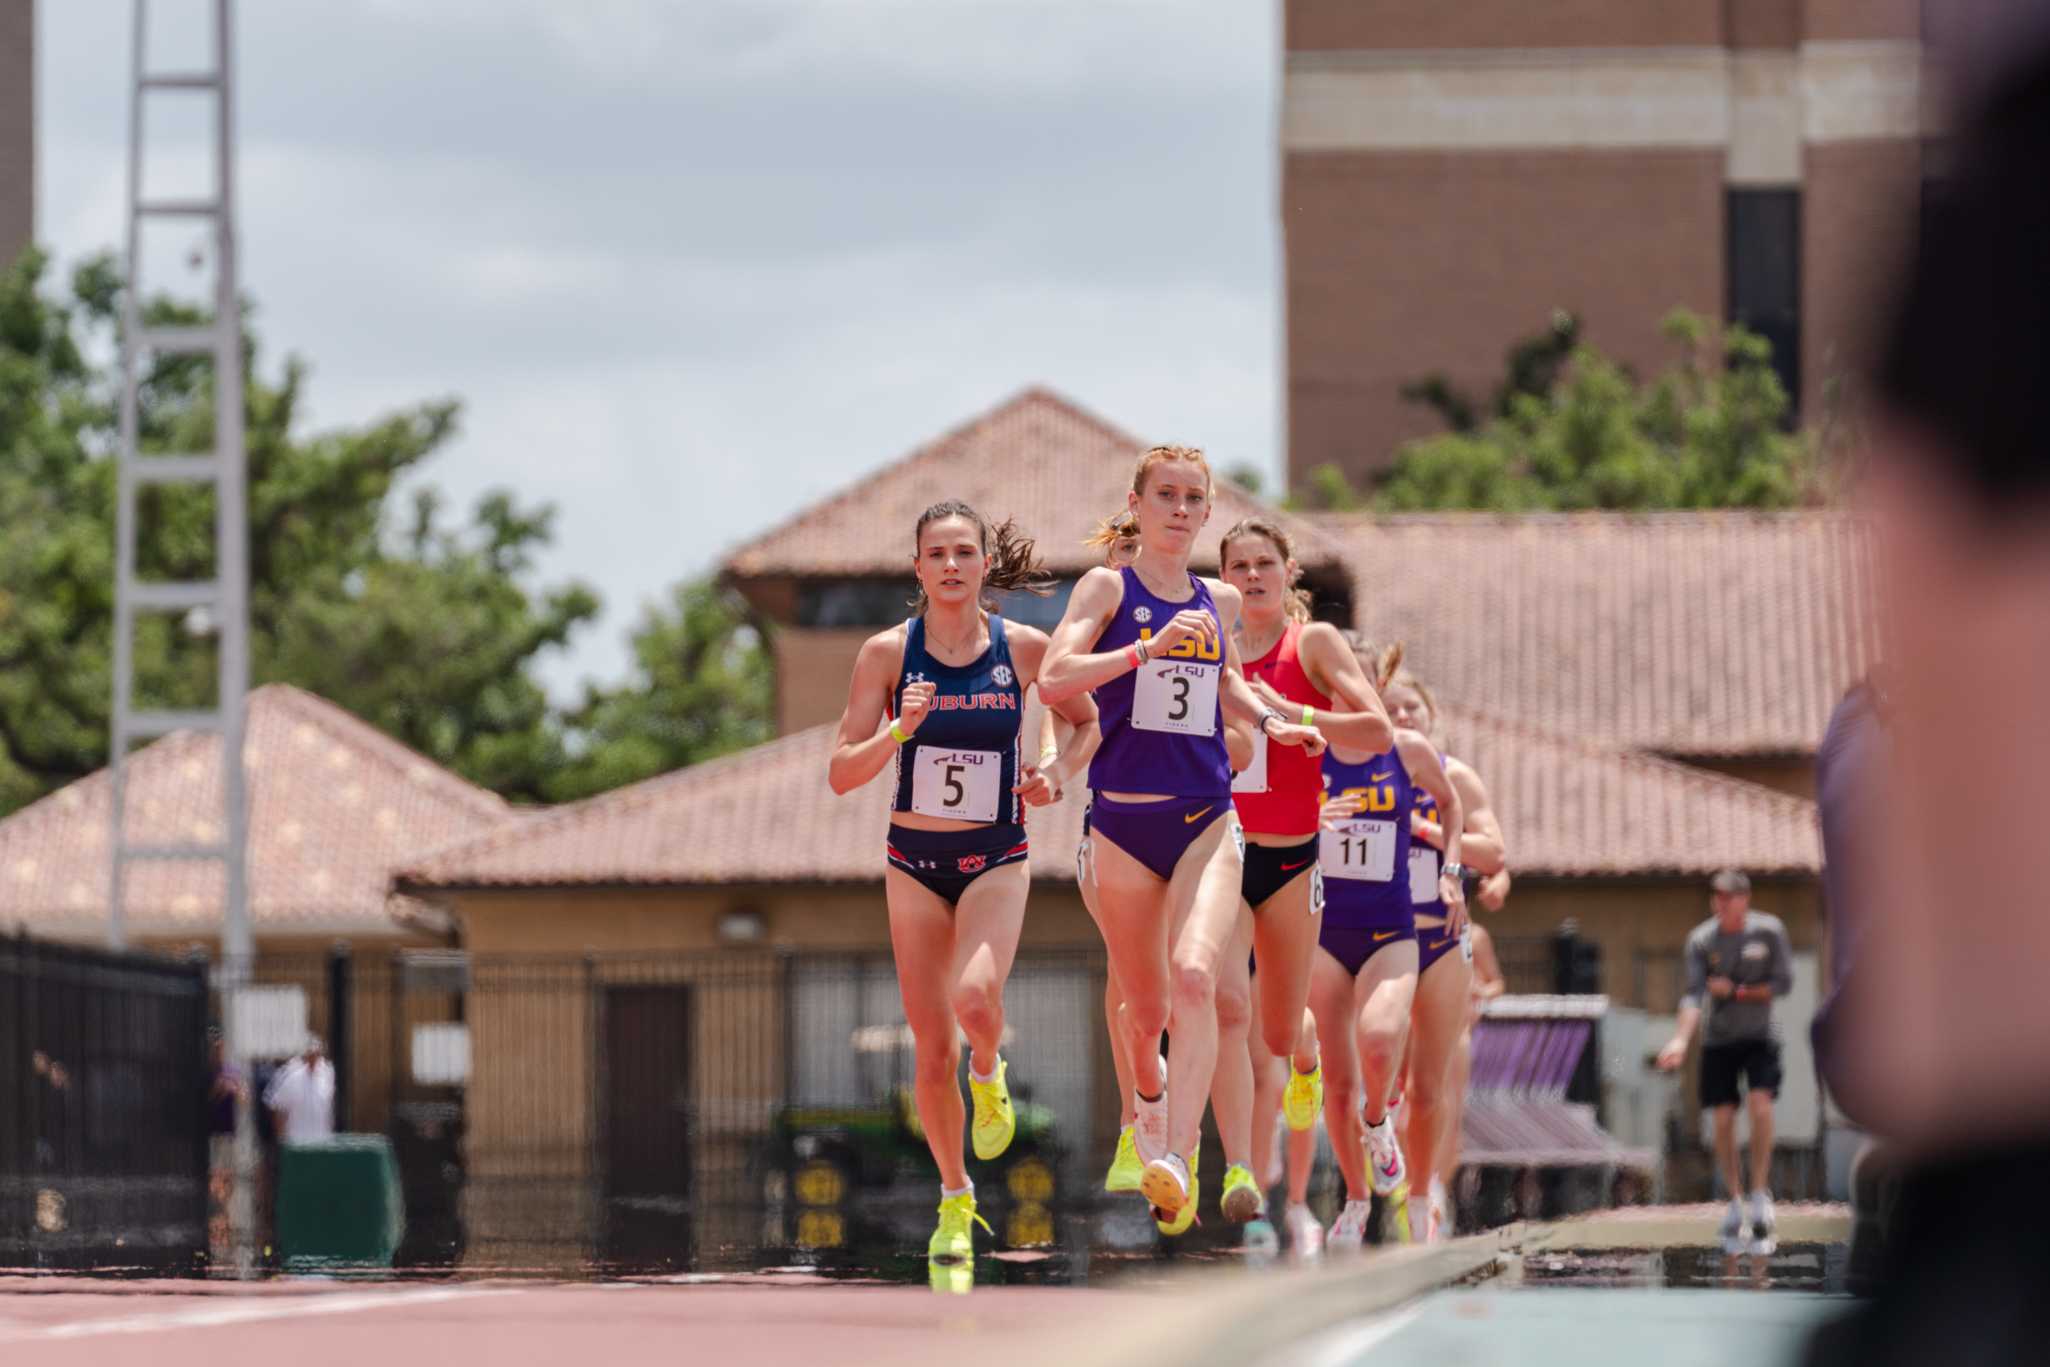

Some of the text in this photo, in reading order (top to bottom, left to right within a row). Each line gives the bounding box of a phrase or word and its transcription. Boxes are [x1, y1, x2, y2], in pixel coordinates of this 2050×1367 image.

[1175, 664, 1205, 678] LSU
[927, 692, 1017, 711] UBURN
[1168, 677, 1190, 720] 3
[952, 753, 984, 765] LSU
[943, 765, 965, 807] 5
[1352, 823, 1381, 834] LSU
[1340, 838, 1367, 866] 11
